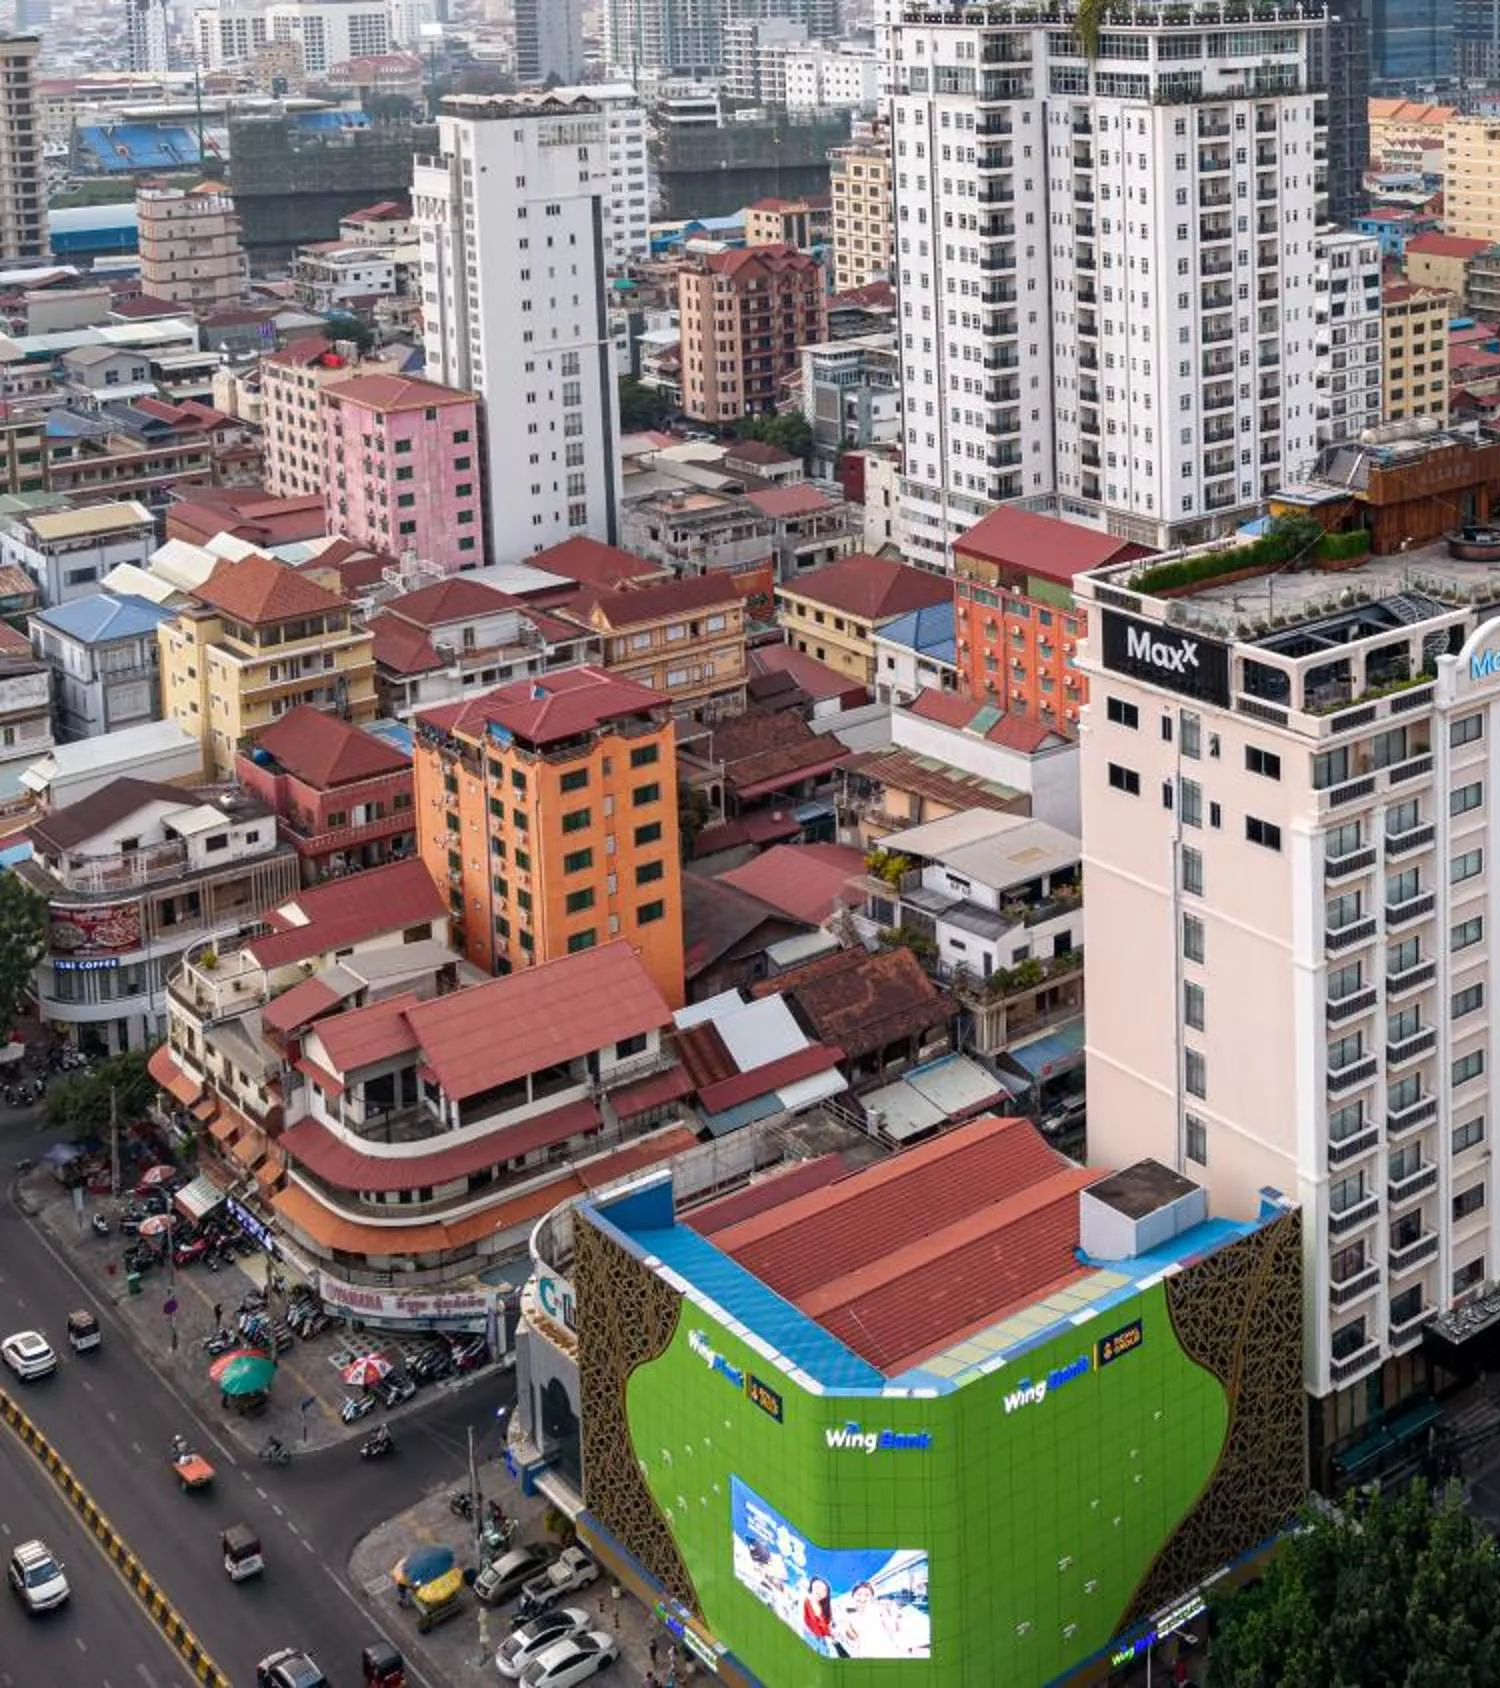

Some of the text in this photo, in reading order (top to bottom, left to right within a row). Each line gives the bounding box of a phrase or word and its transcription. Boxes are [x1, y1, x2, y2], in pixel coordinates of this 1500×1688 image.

[1127, 625, 1199, 673] Maxx
[79, 959, 117, 969] COFFEE
[1003, 1379, 1048, 1415] Wing
[825, 1426, 878, 1455] Wing
